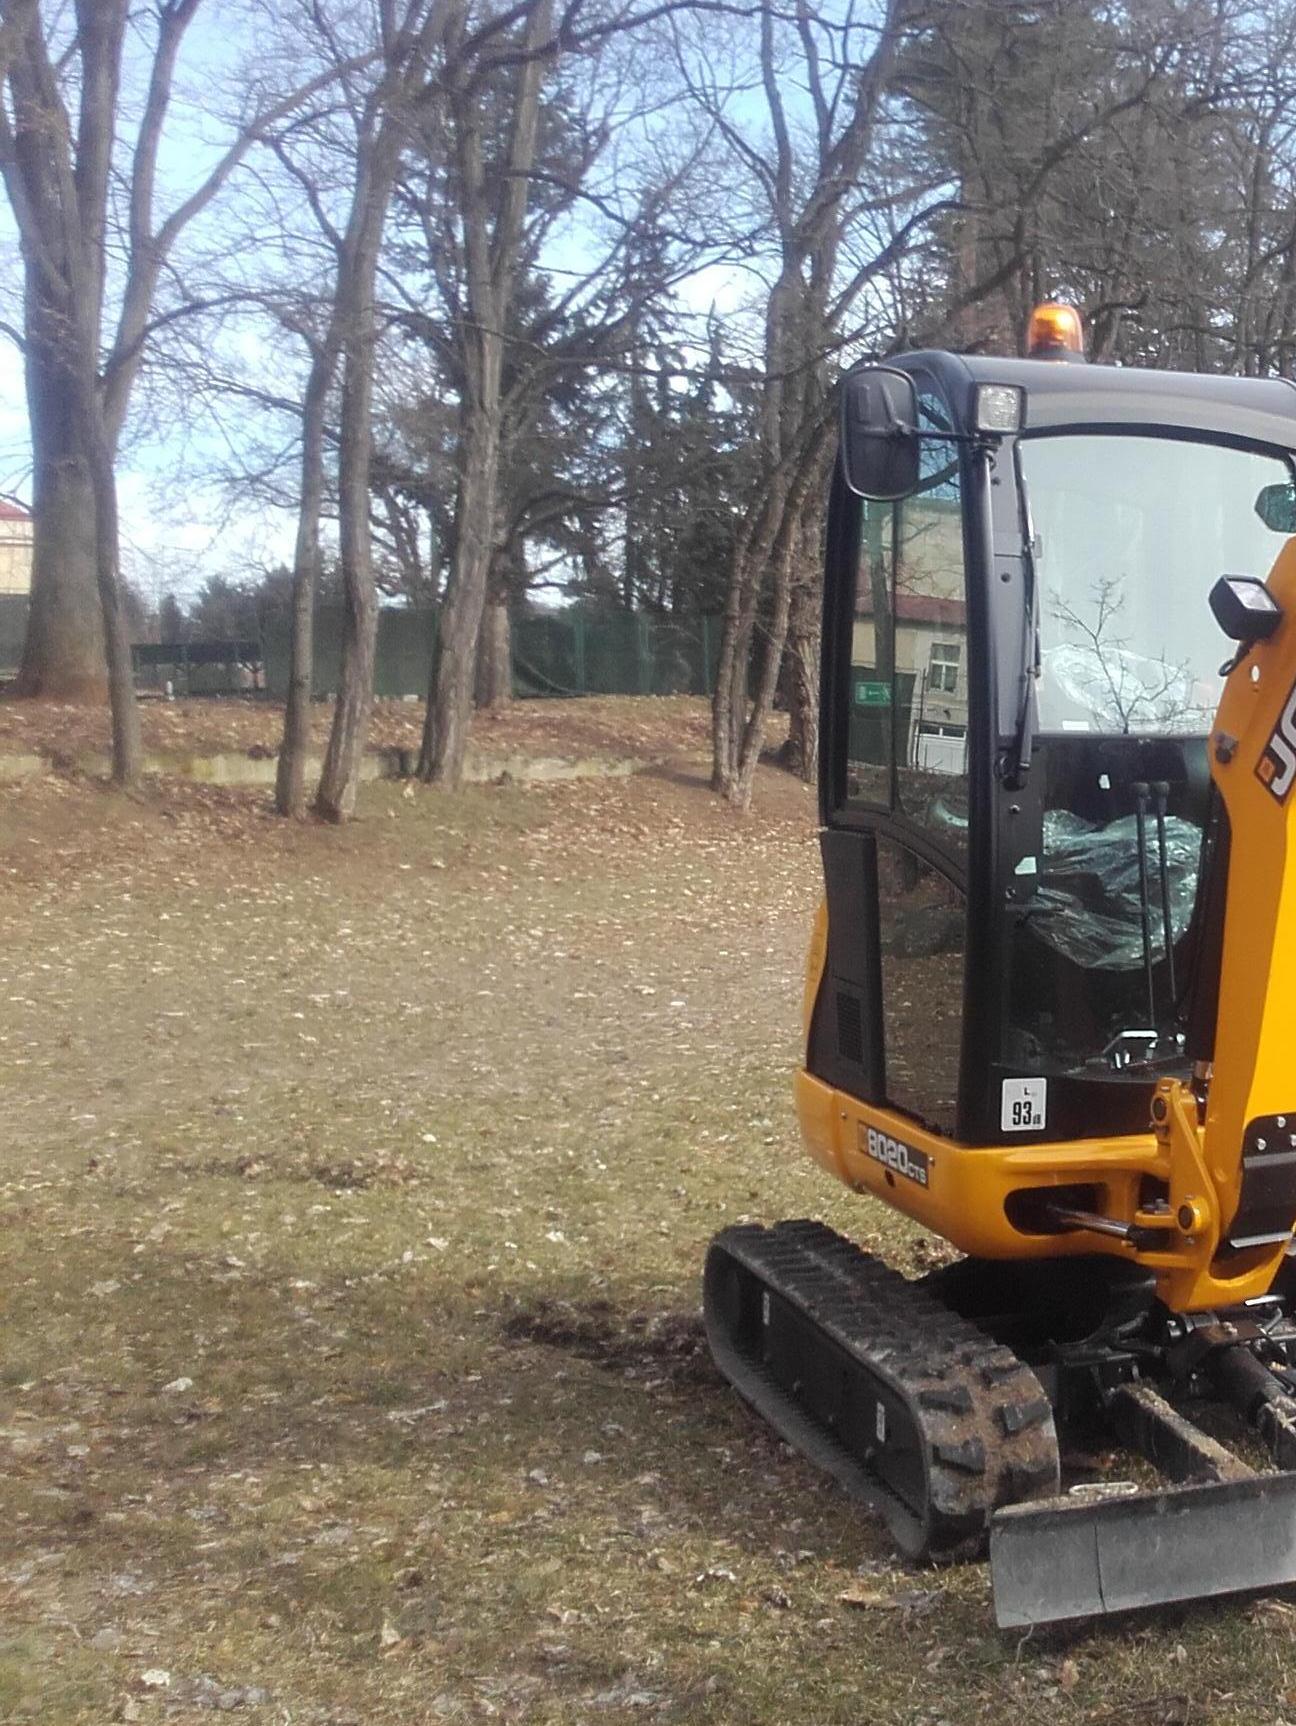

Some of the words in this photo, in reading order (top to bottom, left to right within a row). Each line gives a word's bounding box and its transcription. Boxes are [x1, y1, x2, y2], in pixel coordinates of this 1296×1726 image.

[1013, 1101, 1032, 1125] 93
[868, 1128, 907, 1174] 8020
[909, 1163, 926, 1184] CTS
